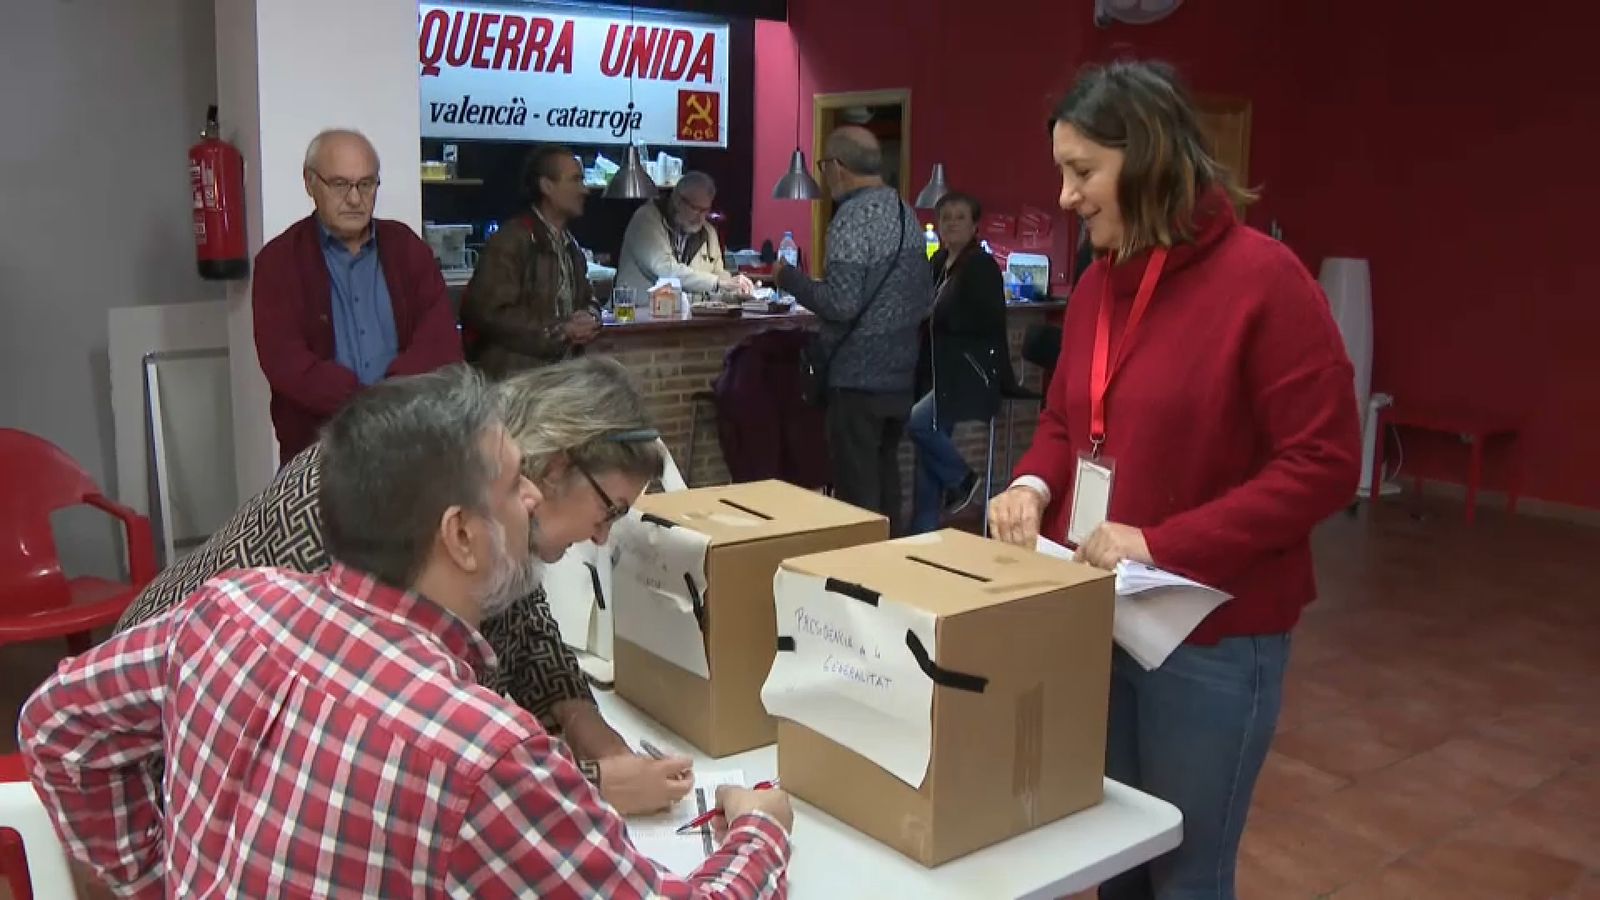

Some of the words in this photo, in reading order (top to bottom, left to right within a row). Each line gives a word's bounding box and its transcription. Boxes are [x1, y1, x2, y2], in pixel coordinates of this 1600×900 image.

[419, 10, 574, 77] QUERRA
[600, 24, 716, 84] UNIDA
[430, 95, 527, 126] valencià
[546, 102, 643, 137] catarroja
